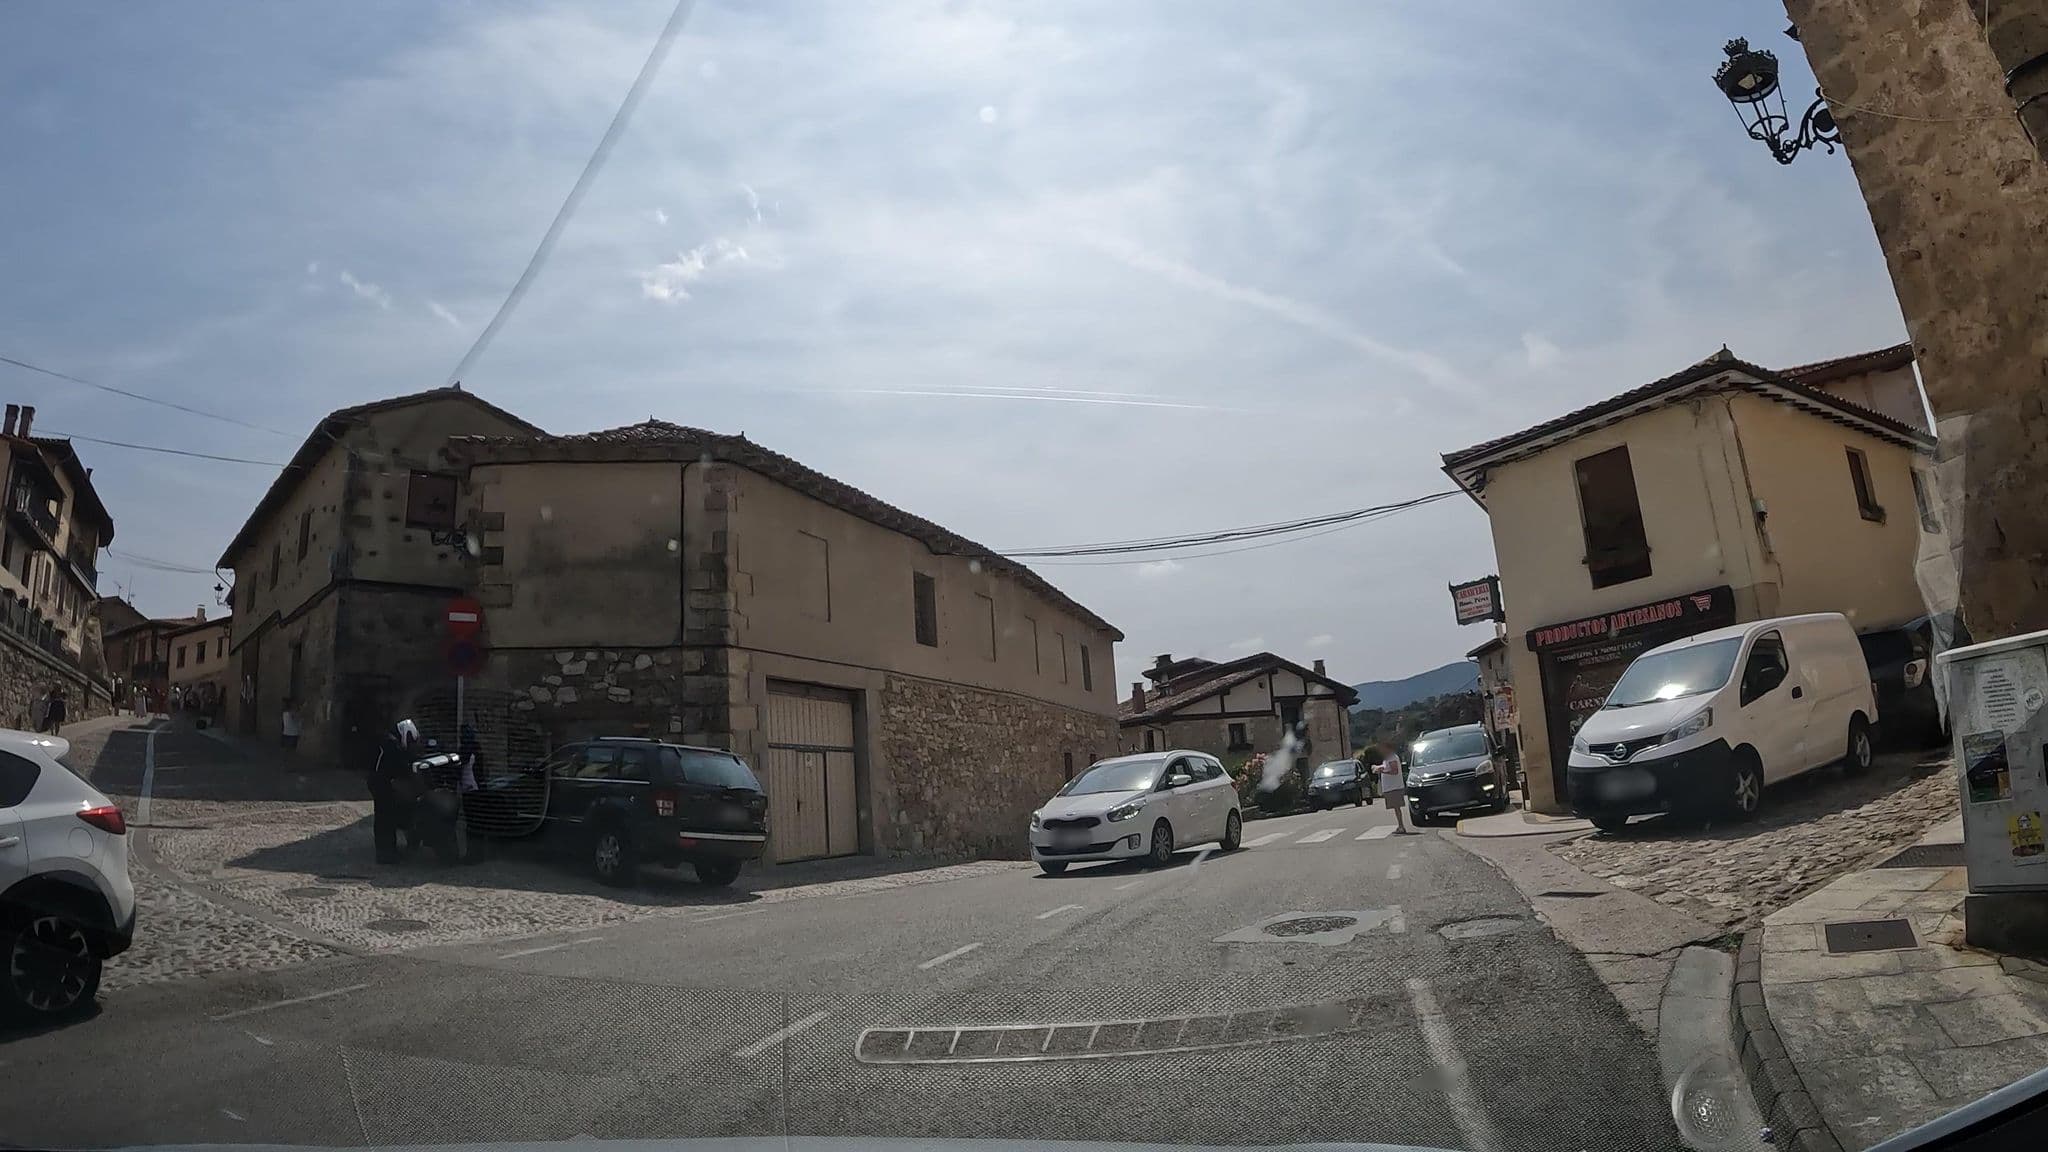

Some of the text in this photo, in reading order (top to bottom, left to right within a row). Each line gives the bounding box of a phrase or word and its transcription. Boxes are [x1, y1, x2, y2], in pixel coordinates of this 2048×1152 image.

[1536, 600, 1683, 647] PRODUCTOS ARTESANOS
[1569, 696, 1604, 711] CARN
